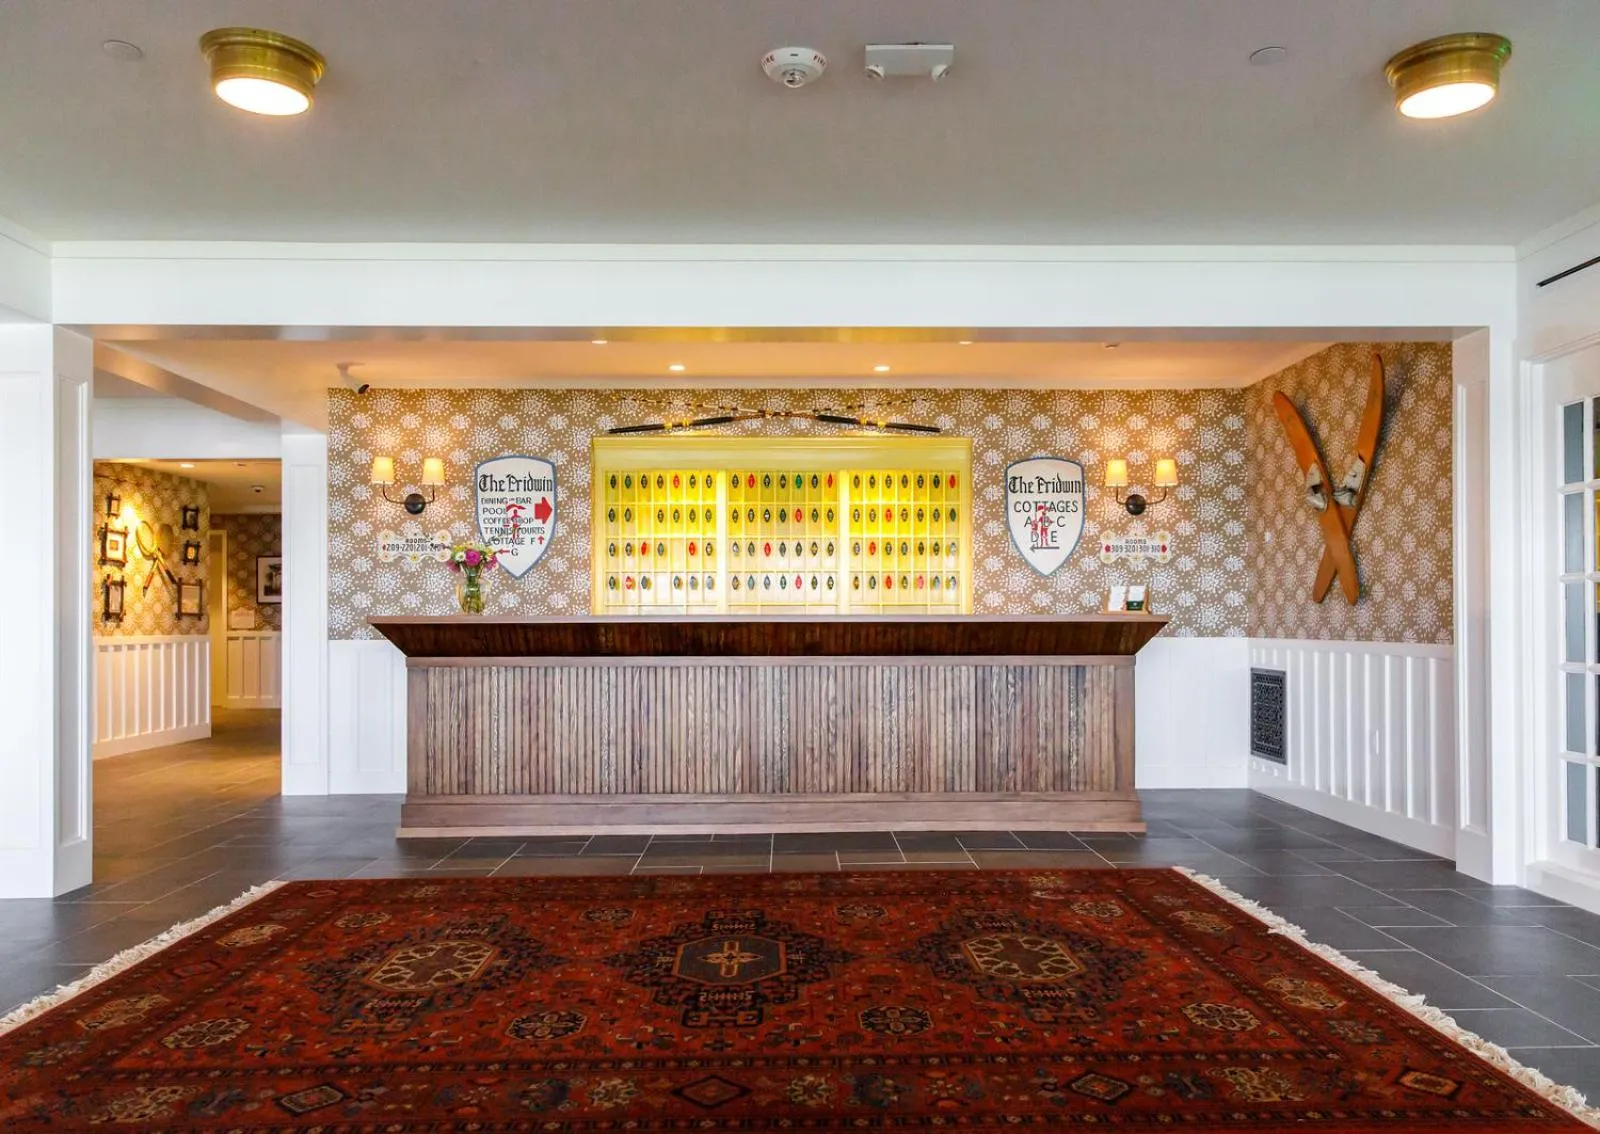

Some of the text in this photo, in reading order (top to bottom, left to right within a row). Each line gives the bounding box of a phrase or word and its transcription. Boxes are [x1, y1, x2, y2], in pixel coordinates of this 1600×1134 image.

[479, 472, 553, 493] The Pridwin
[1008, 473, 1081, 494] The Pridwin
[481, 497, 509, 505] DINING
[516, 497, 532, 505] BAR
[483, 507, 508, 515] POOL
[1014, 501, 1078, 513] COTTAGES
[1024, 516, 1033, 528] A
[1057, 516, 1066, 528] C
[484, 526, 545, 535] TENNIS COURTS
[486, 537, 525, 546] OTTAGE
[1031, 531, 1058, 543] D E
[511, 548, 519, 556] G
